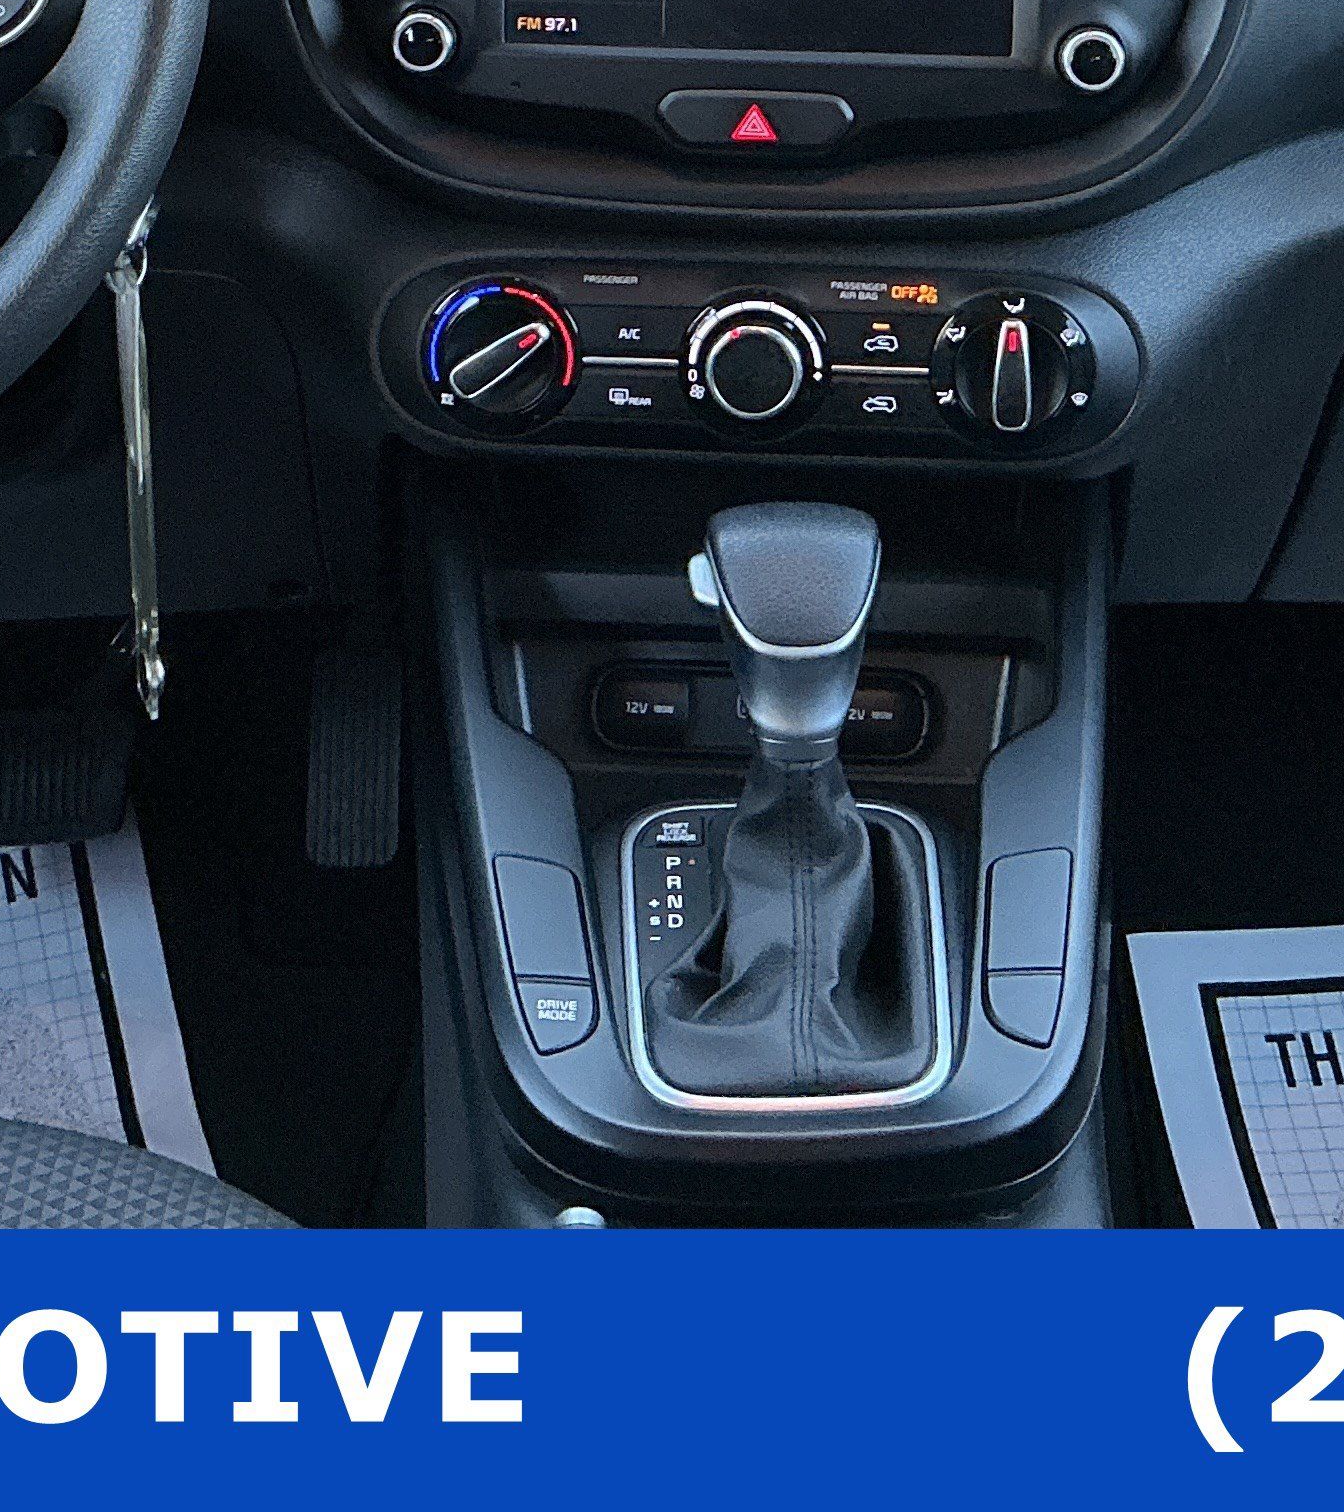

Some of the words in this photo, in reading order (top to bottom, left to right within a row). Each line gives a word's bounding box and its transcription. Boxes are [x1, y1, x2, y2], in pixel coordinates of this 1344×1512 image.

[517, 16, 542, 31] FM
[544, 18, 577, 32] 97.1
[891, 285, 918, 299] OFF
[618, 327, 641, 340] A/C
[665, 856, 681, 871] P
[666, 875, 682, 890] R
[667, 894, 683, 909] N
[668, 913, 684, 929] D
[537, 999, 577, 1011] DRIVE
[538, 1009, 576, 1021] MODE
